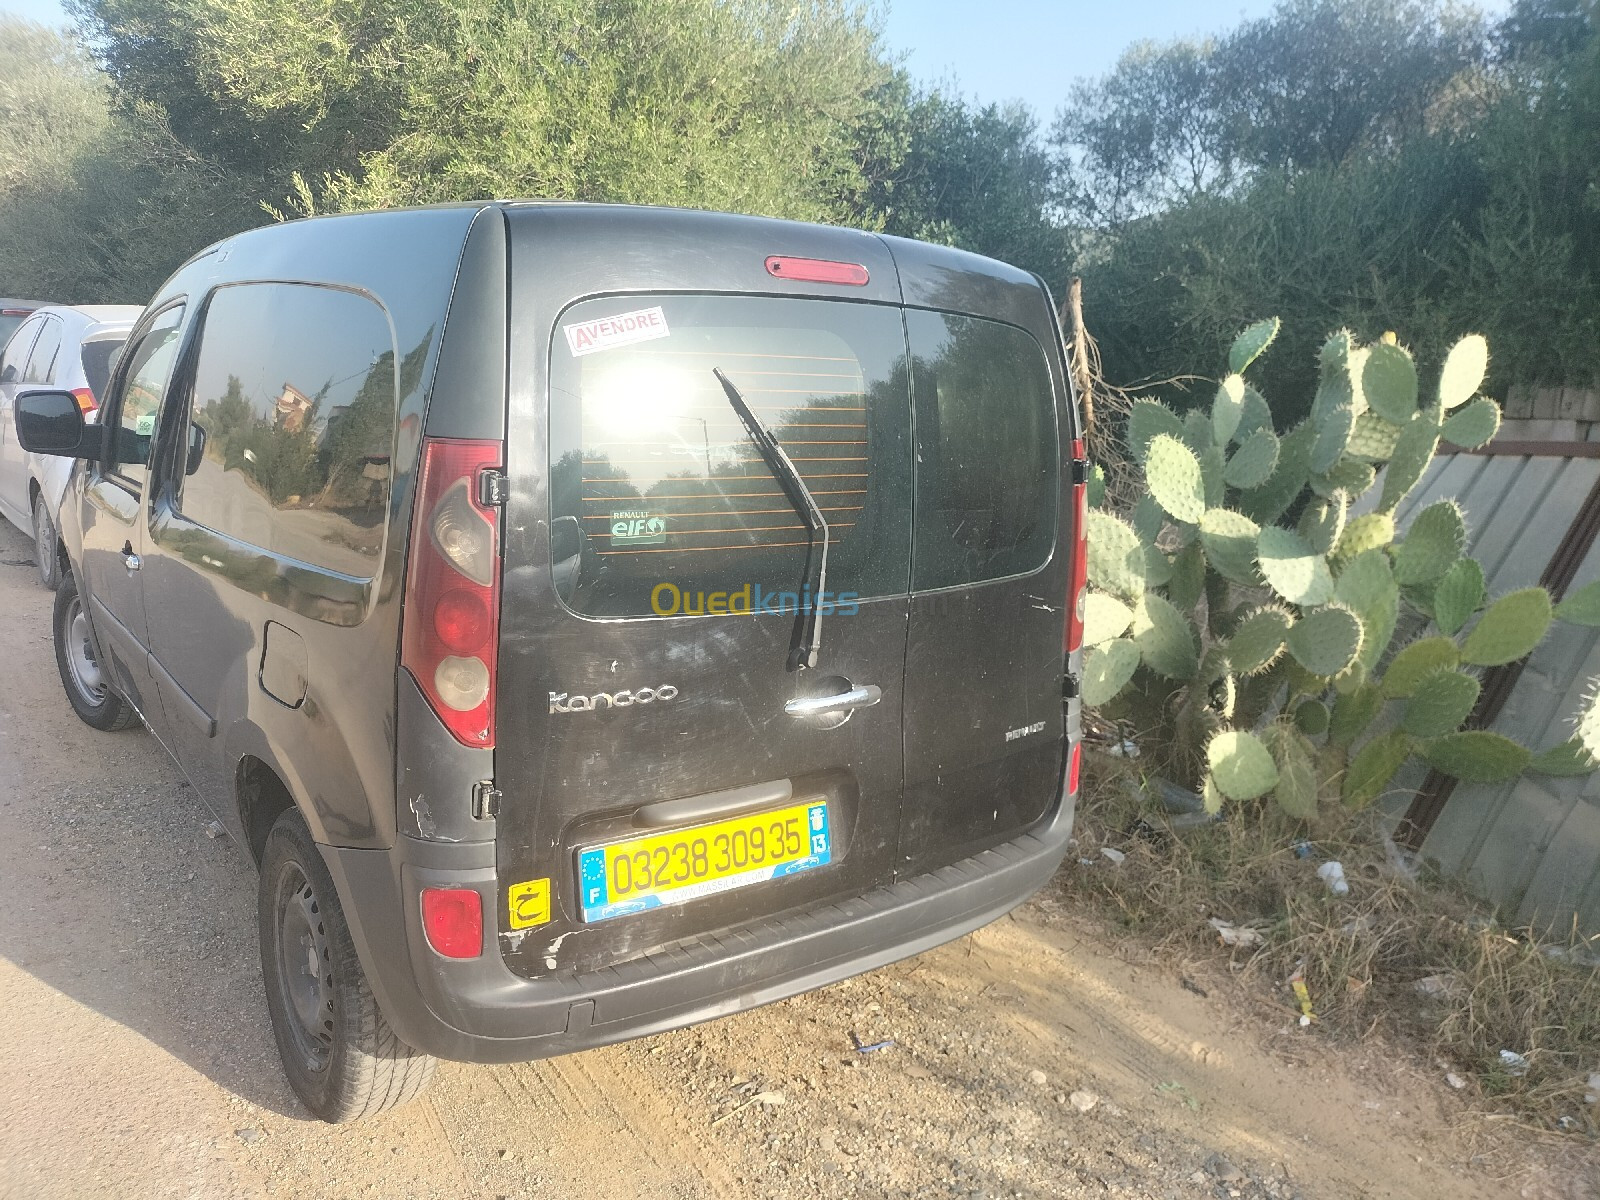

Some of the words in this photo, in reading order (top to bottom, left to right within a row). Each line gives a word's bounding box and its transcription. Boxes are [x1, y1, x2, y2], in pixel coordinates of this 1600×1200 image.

[613, 511, 649, 519] RENAULT
[811, 833, 827, 854] 13
[613, 838, 708, 894] 03238
[713, 826, 765, 872] 309
[769, 818, 801, 858] 35
[589, 887, 601, 904] F
